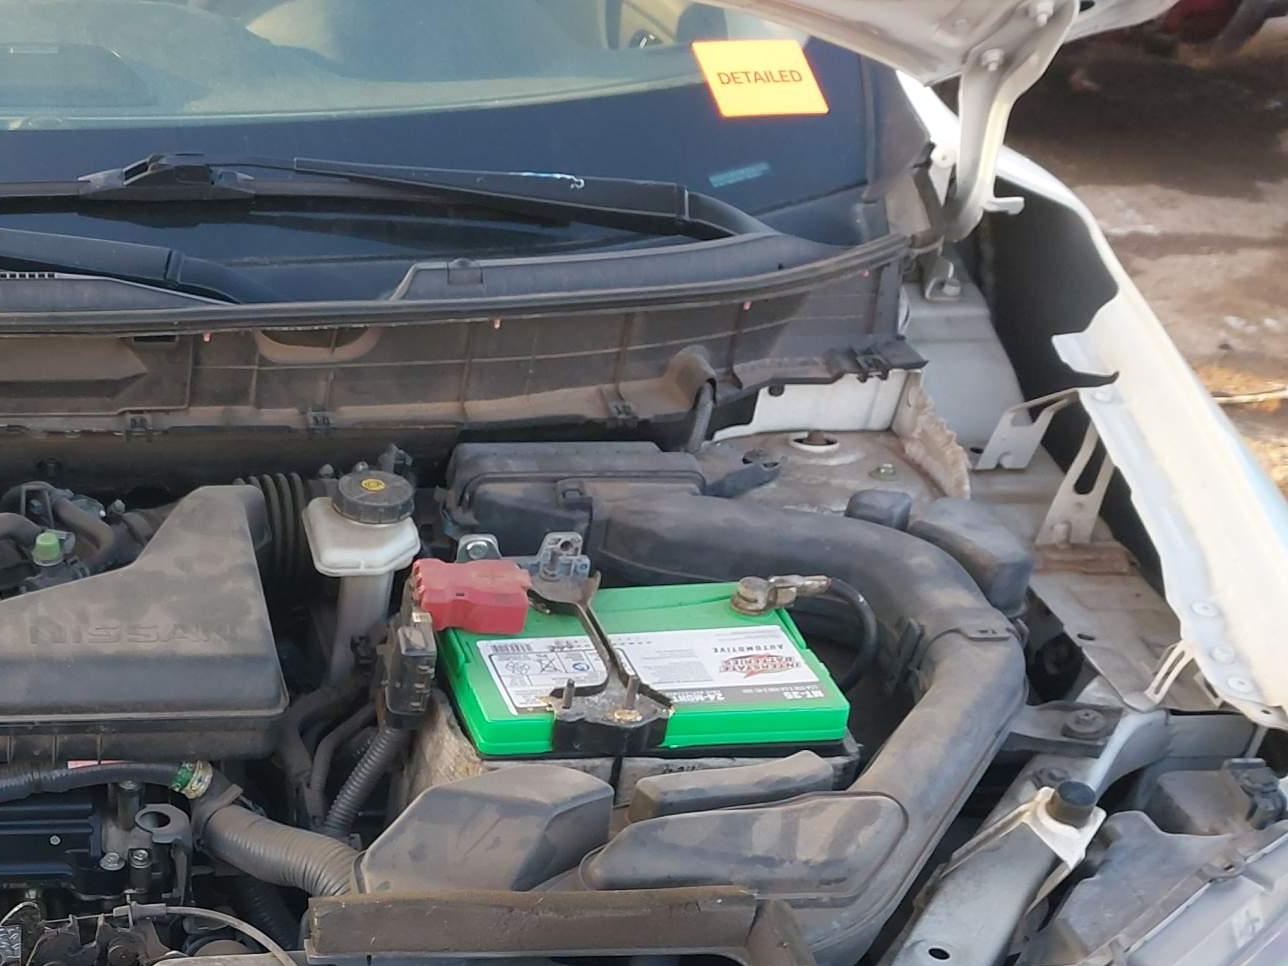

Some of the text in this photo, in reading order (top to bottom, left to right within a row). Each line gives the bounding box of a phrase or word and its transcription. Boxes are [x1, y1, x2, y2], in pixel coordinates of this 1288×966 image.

[716, 69, 803, 85] DETAILED
[29, 622, 230, 645] NISSAN
[711, 644, 784, 654] AUTOMOTIVE
[718, 661, 802, 674] INTERSTATE
[722, 656, 795, 667] BATTERIES
